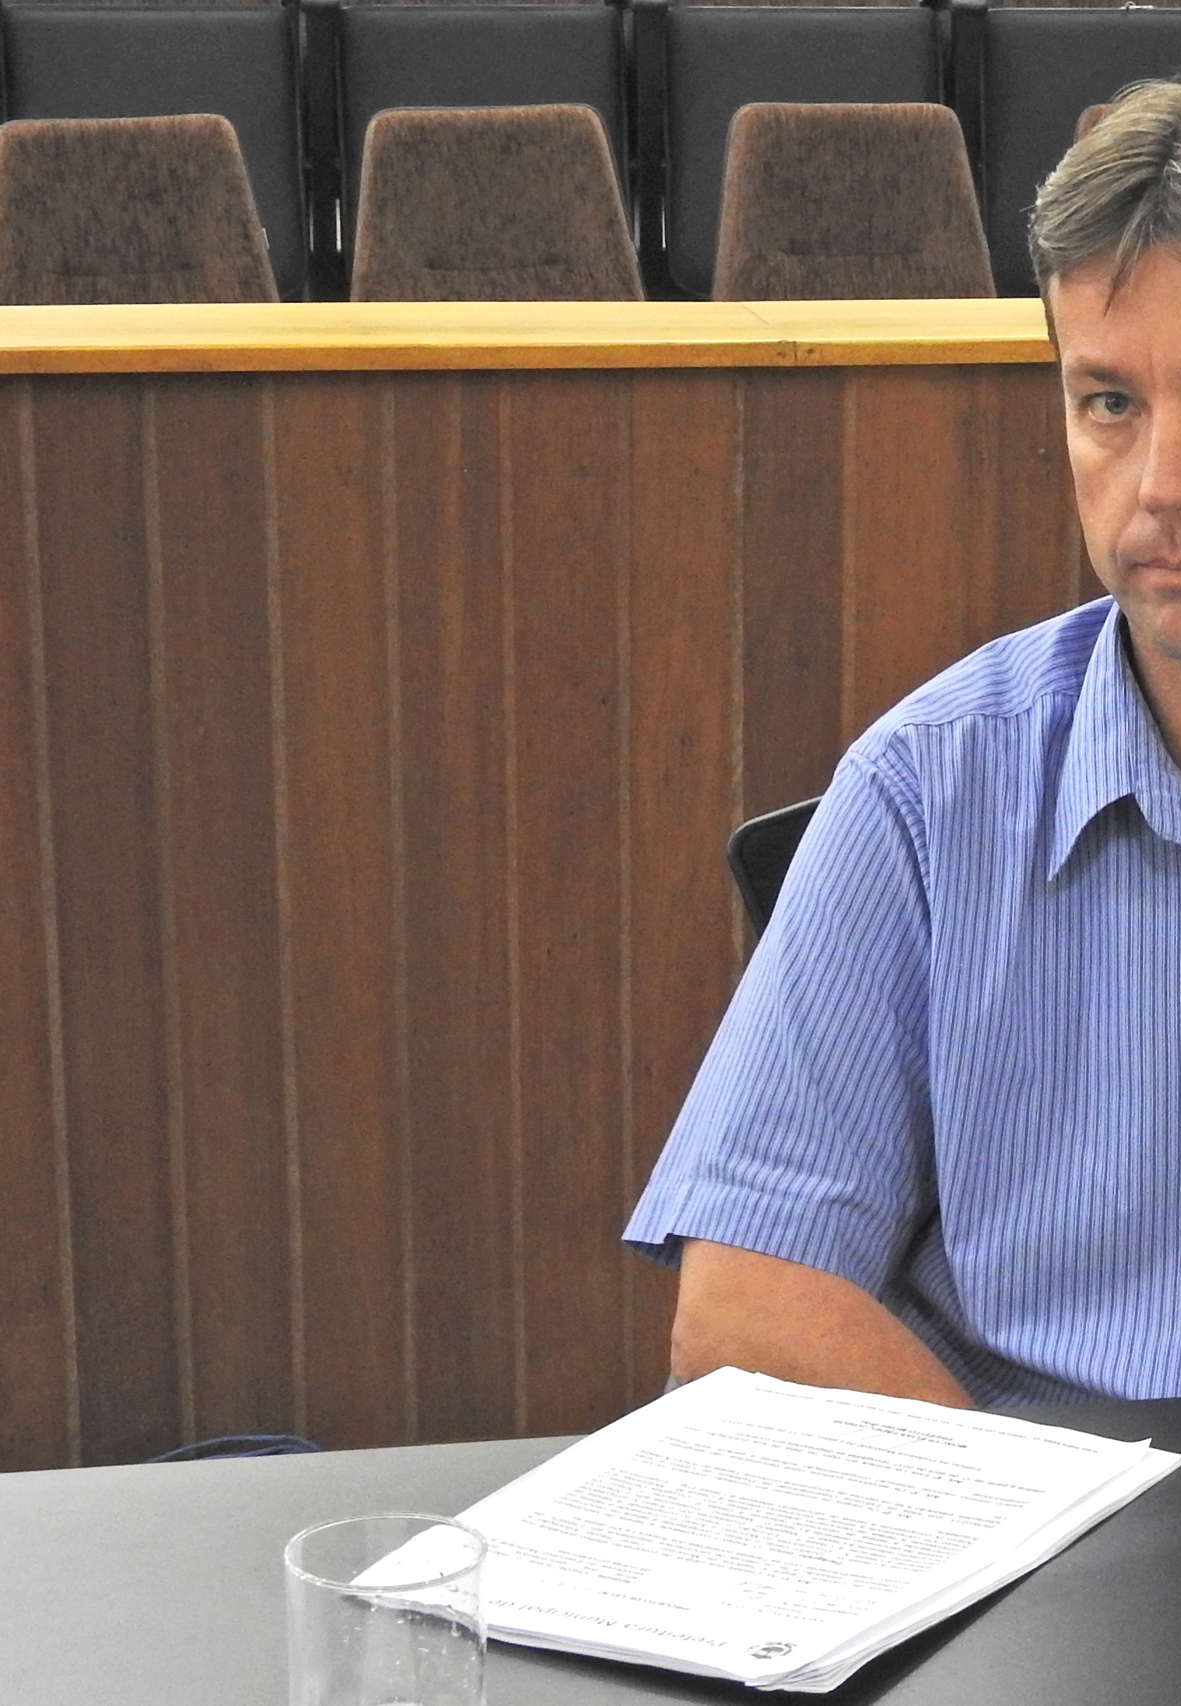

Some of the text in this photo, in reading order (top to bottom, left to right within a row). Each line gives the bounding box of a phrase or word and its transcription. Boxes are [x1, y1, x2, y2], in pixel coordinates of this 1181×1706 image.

[488, 1599, 728, 1648] Prefeitura Municipal de
